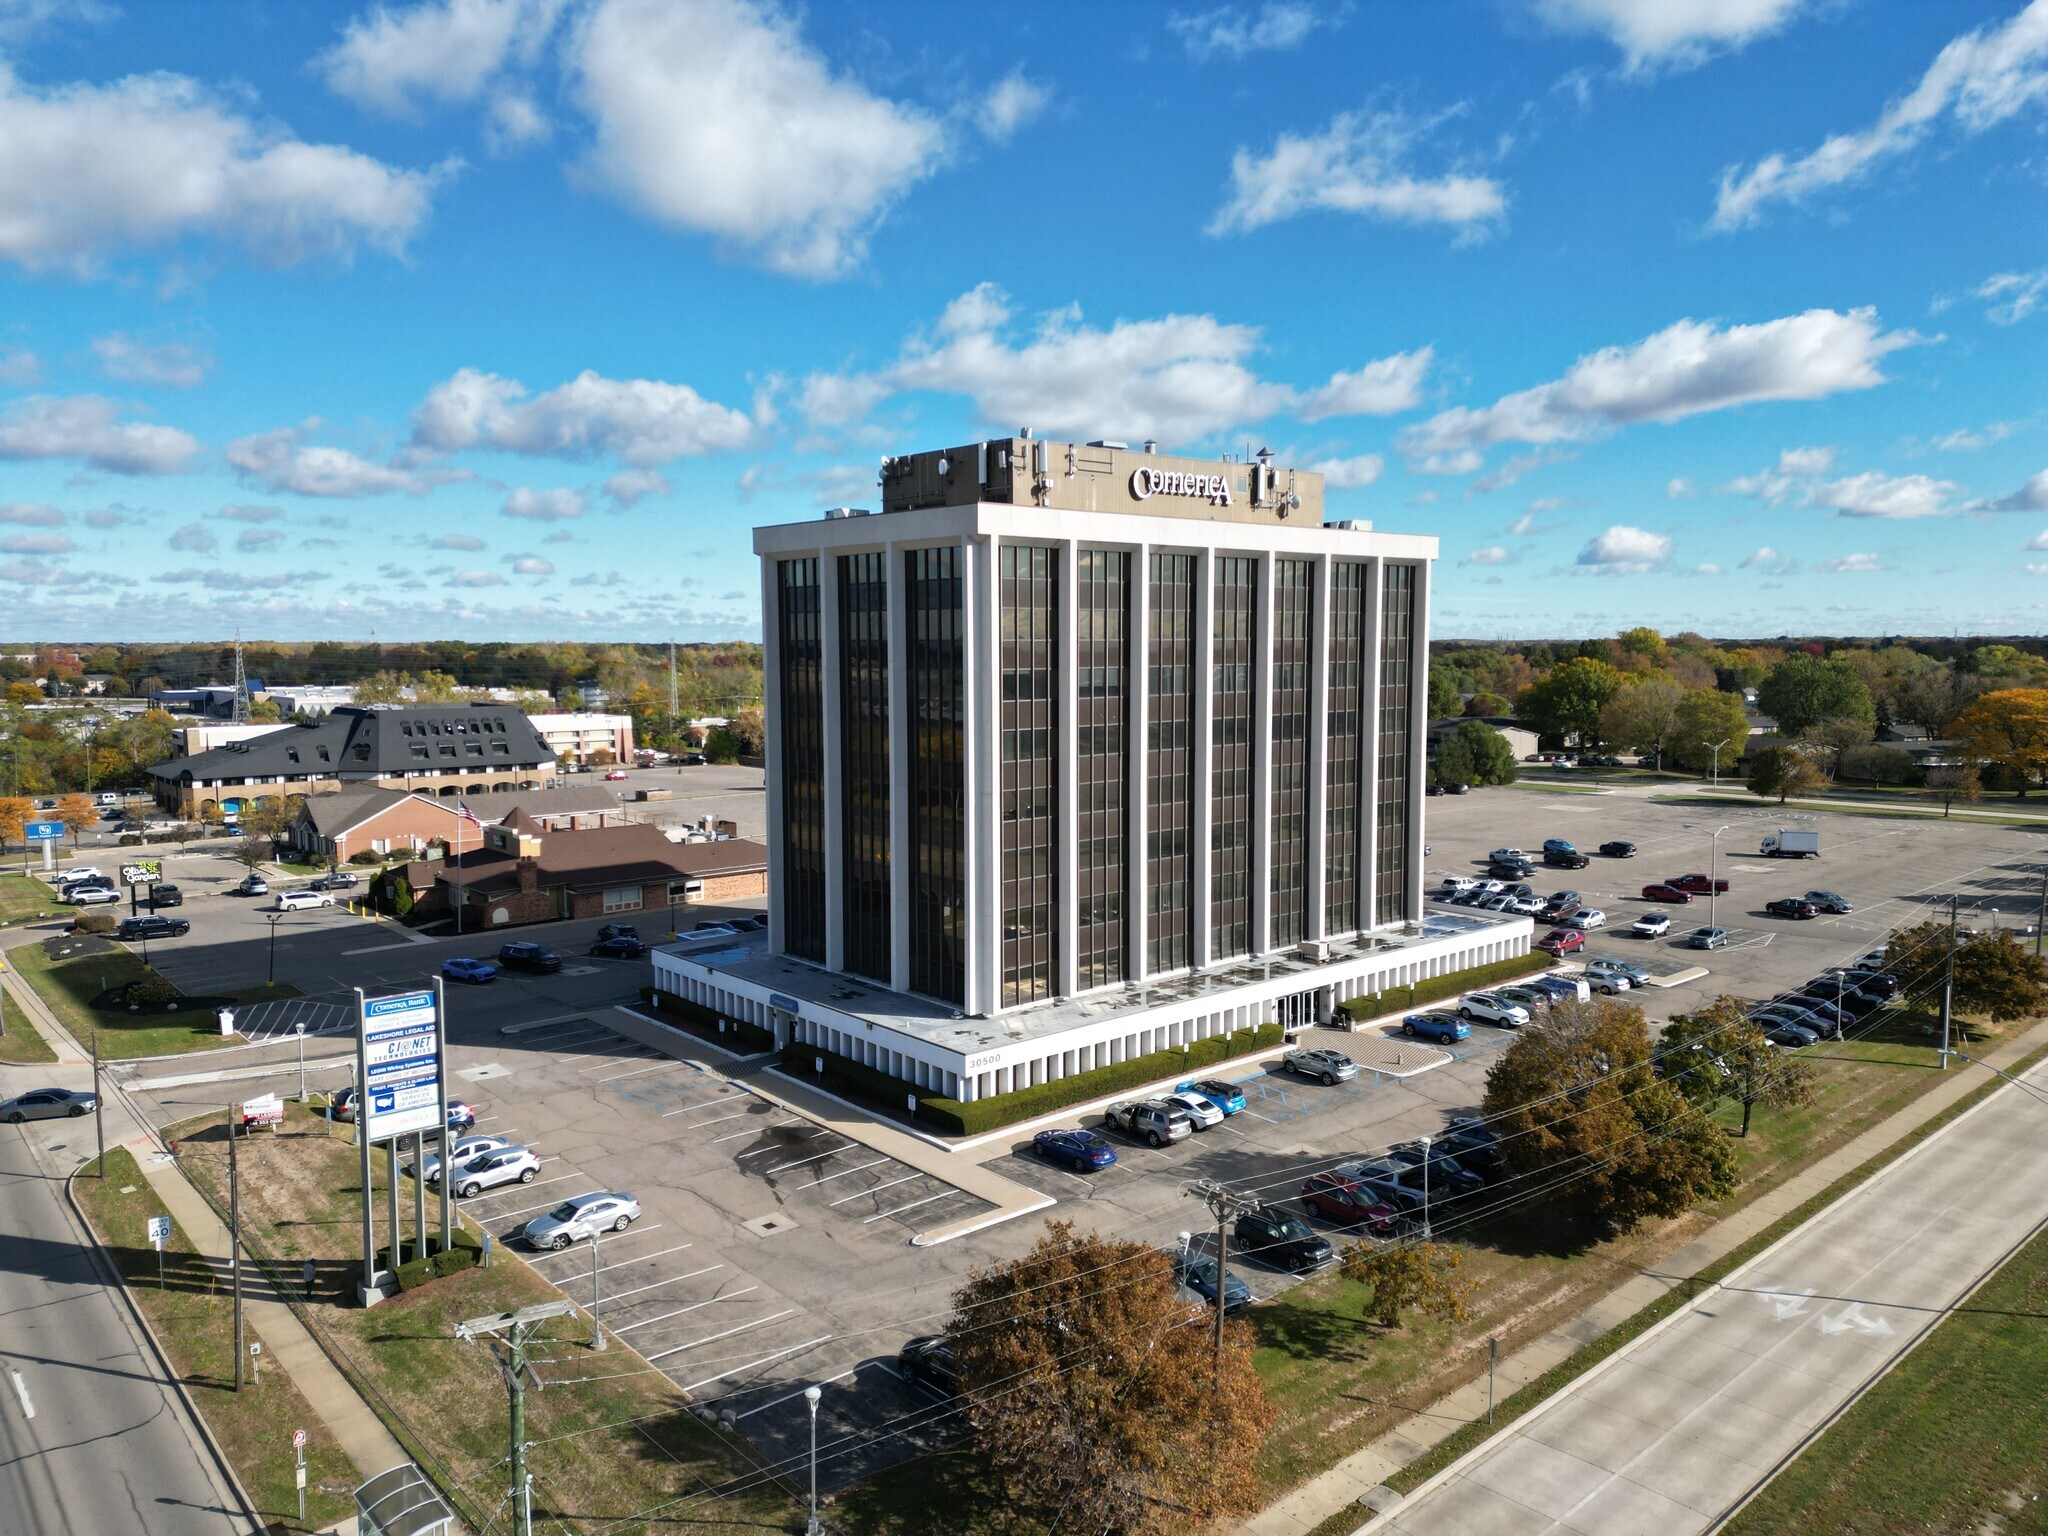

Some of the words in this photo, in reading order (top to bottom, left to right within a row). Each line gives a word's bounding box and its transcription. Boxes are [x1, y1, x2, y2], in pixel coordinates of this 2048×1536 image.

[123, 866, 147, 875] Olive
[127, 873, 160, 884] Garden
[367, 1030, 404, 1041] LAKESHORE
[405, 1026, 424, 1034] LEGAL
[374, 1047, 431, 1062] TECHNOLOGIES
[970, 1054, 1000, 1068] 30500
[400, 1087, 430, 1096] FINANCIAL
[402, 1092, 430, 1101] SERVICES
[408, 1096, 434, 1105] AMERICA
[152, 1228, 168, 1237] 40
